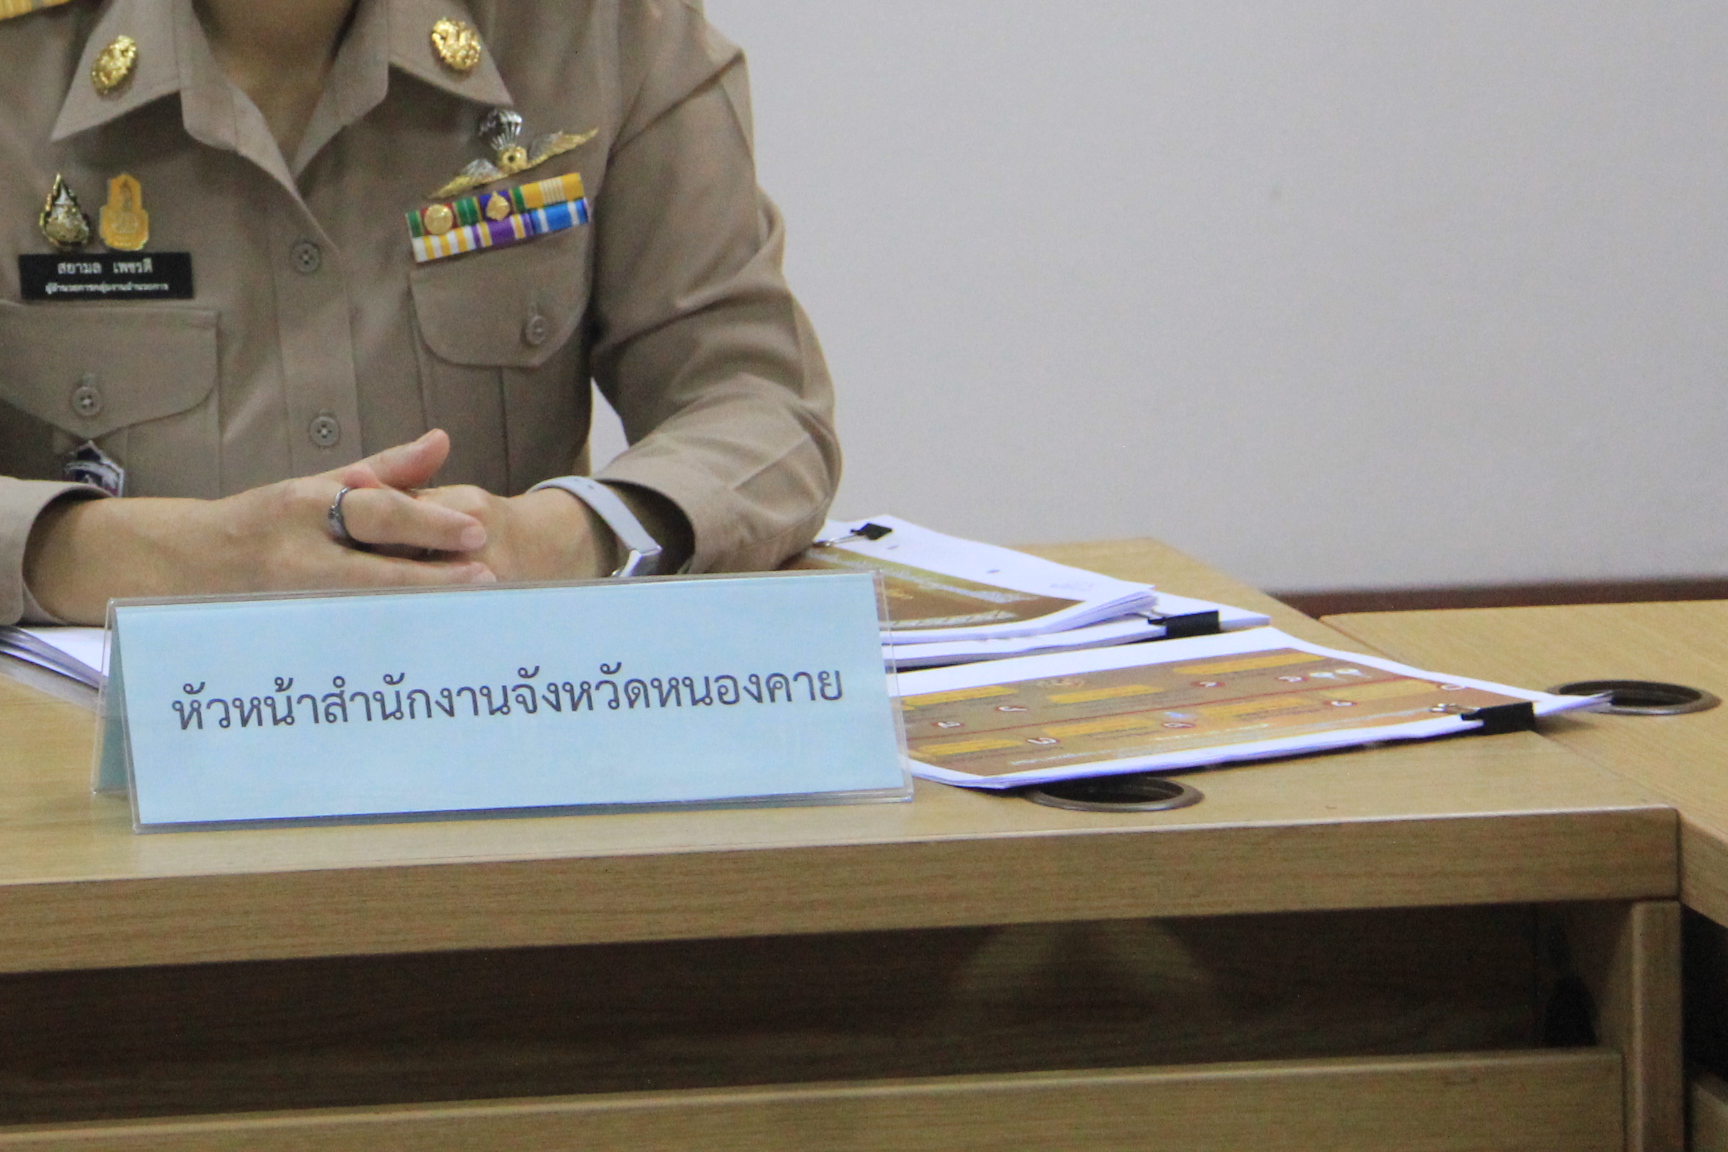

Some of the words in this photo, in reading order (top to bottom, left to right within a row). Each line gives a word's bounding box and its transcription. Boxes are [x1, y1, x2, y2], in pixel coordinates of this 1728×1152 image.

[172, 662, 843, 731] หัวหน้าสำนักงานจังหวัดหนองคาย
